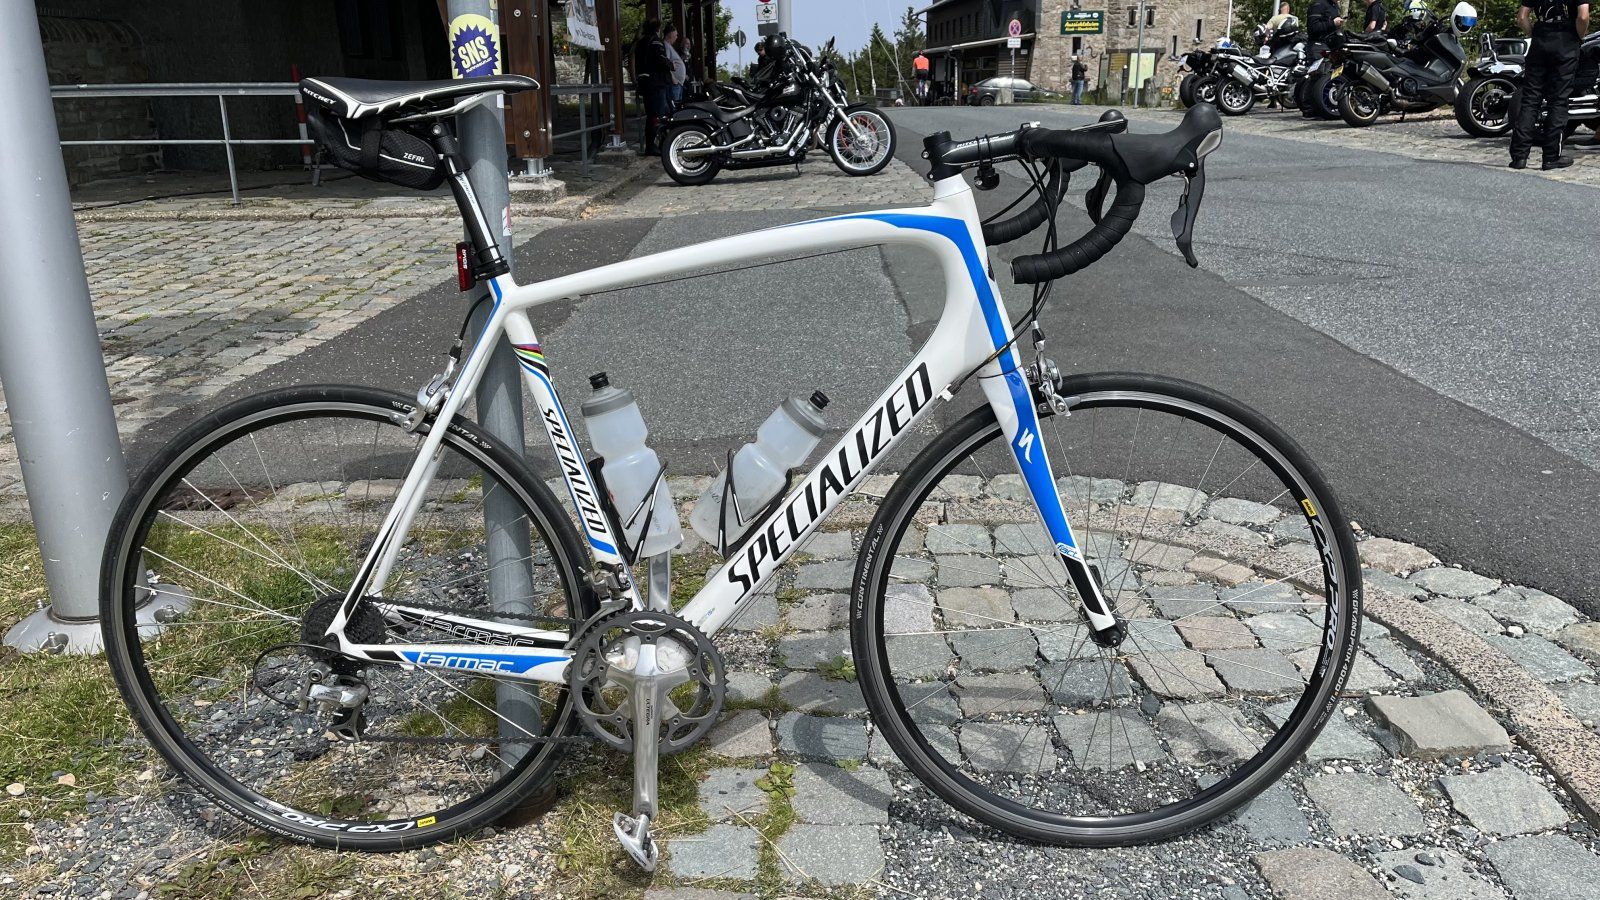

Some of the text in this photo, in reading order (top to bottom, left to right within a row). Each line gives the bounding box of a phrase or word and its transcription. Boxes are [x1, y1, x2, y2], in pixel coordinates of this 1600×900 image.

[457, 36, 489, 69] SNS
[303, 87, 337, 105] RITCHEY
[540, 403, 607, 534] SPECIALIZED
[727, 361, 933, 605] SPECIALIZED
[857, 535, 880, 611] CONTINENTAL
[1350, 599, 1360, 638] GRAND
[416, 651, 515, 673] tarmac
[1345, 637, 1355, 664] PRIX
[1335, 663, 1348, 691] 4000
